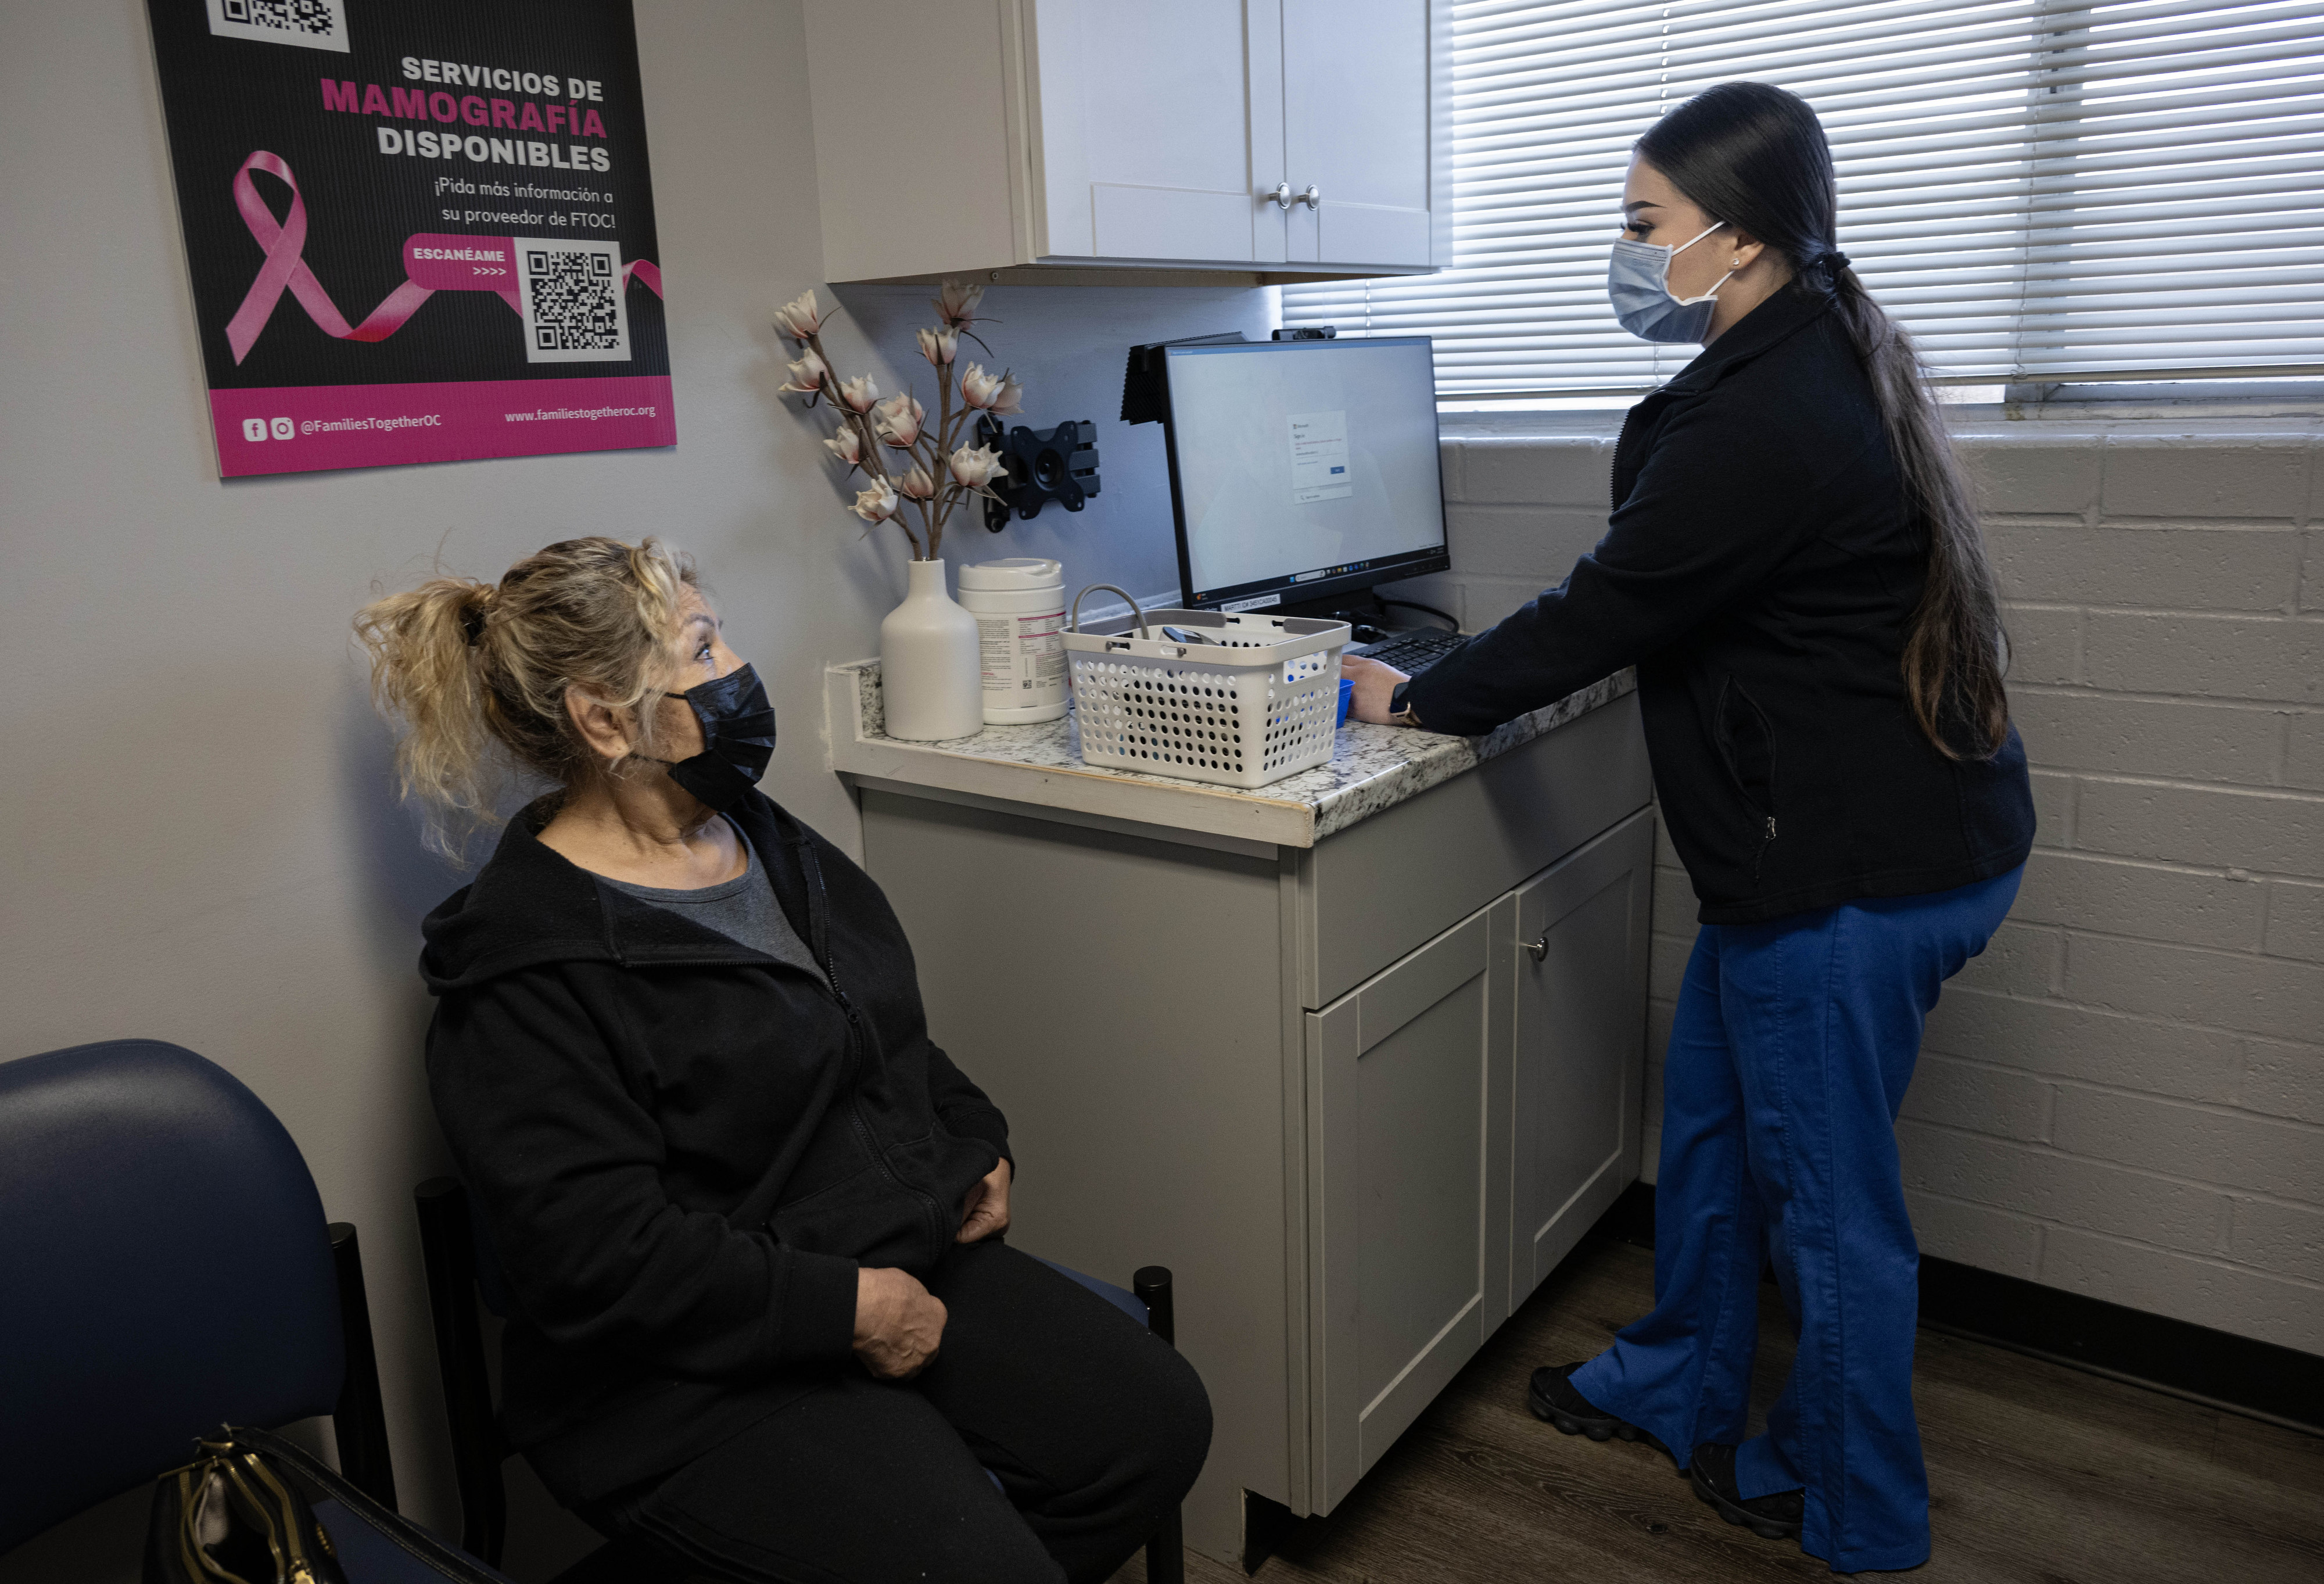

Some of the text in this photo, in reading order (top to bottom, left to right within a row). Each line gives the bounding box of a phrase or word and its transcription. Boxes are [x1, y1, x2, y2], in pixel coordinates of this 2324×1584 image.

[401, 56, 604, 102] SERVICIOS DE
[320, 78, 608, 139] MAMOGRAFÍA
[376, 126, 611, 172] DISPONIBLES
[435, 177, 614, 203] ¡Pida más información a
[442, 209, 616, 228] su proveedor de FTOC!
[413, 247, 505, 262] ESCANÉAME
[300, 414, 442, 435] @FamiliesTogetherOC
[504, 406, 656, 422] www.familiestogetheroc.org
